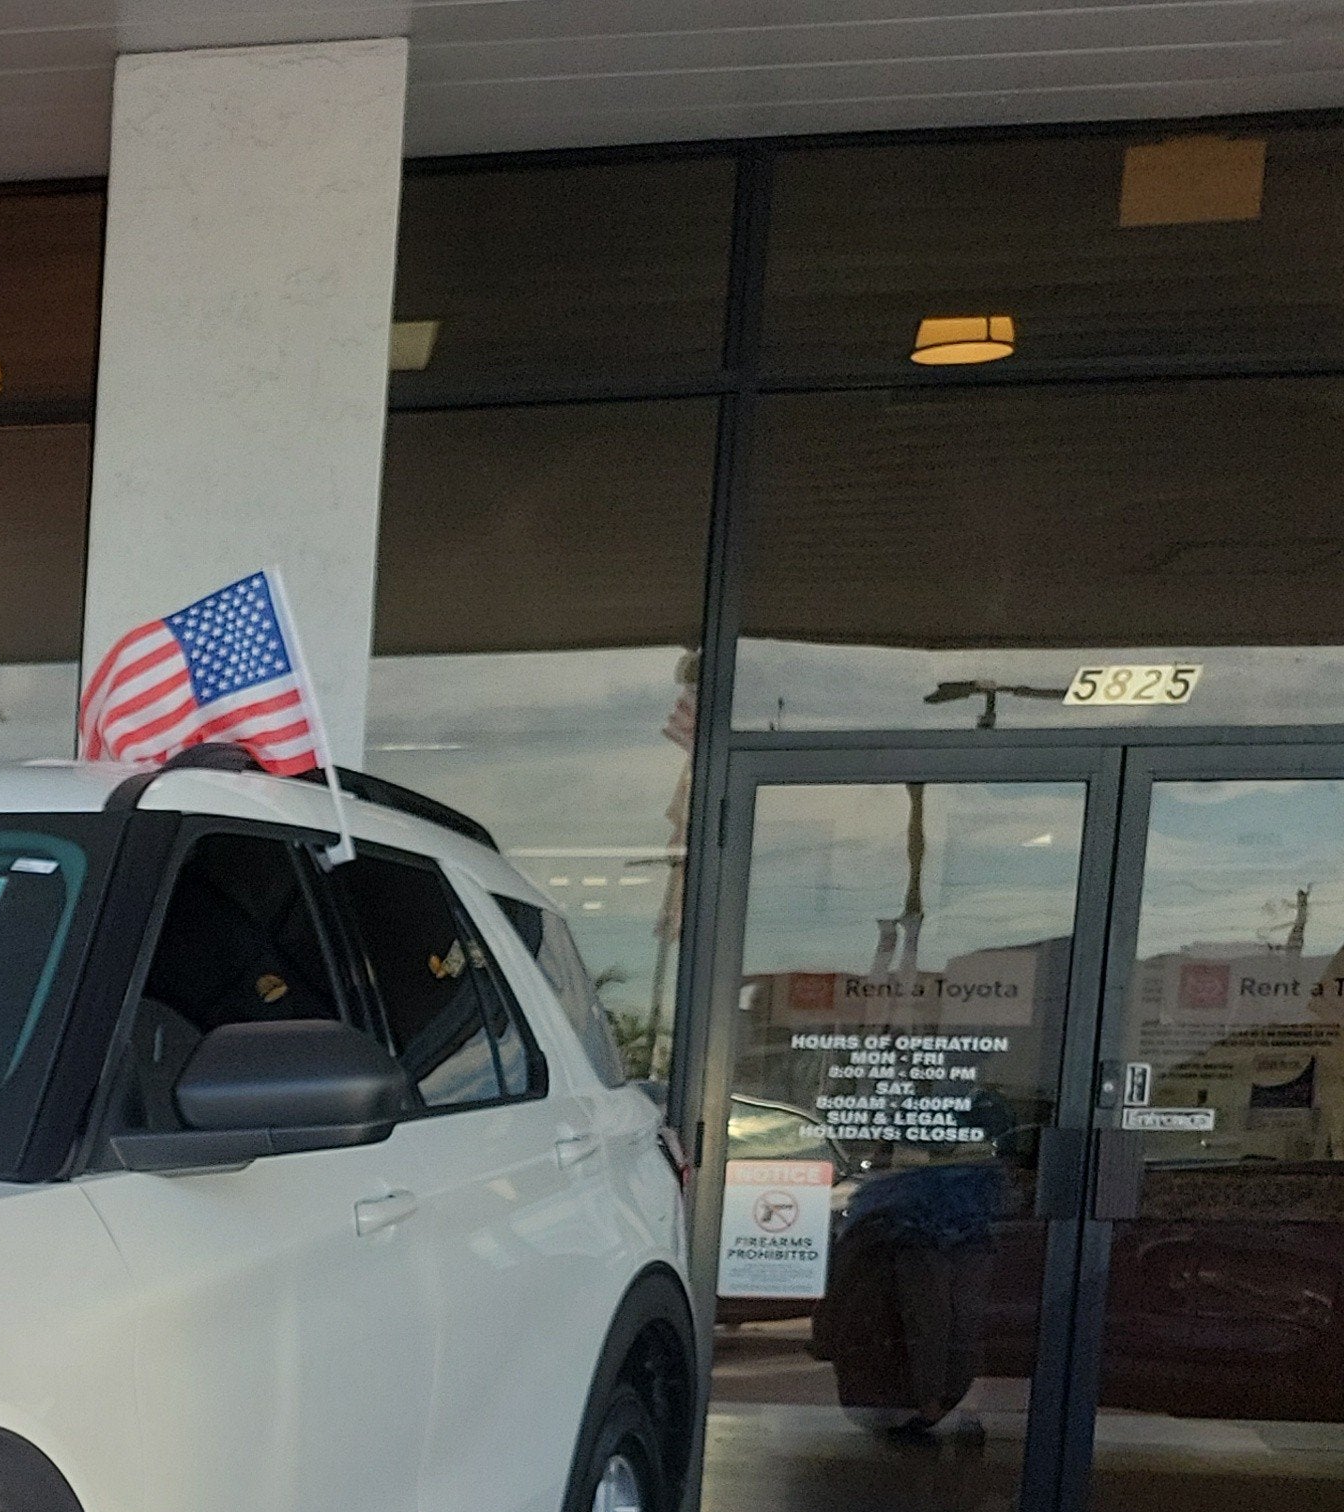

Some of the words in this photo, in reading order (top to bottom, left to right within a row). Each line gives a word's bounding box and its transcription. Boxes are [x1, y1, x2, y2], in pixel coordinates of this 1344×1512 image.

[1073, 668, 1195, 701] 5825
[845, 979, 901, 998] Rent
[934, 979, 1018, 1002] Toyota
[1239, 977, 1300, 997] Rent
[1311, 982, 1323, 997] a
[790, 1034, 861, 1050] HOURS
[863, 1034, 892, 1050] OF
[894, 1034, 1009, 1051] OPERATION
[849, 1051, 896, 1065] MON
[911, 1051, 944, 1066] FRI
[867, 1066, 896, 1079] AM
[949, 1066, 976, 1081] PM
[900, 1097, 972, 1112] 4:00PM
[826, 1110, 868, 1124] SUN
[872, 1110, 887, 1125] &
[894, 1111, 957, 1126] LEGAL
[905, 1125, 984, 1142] CLOSED
[735, 1236, 813, 1247] FIREARMS
[727, 1249, 819, 1261] PROHIBITED
